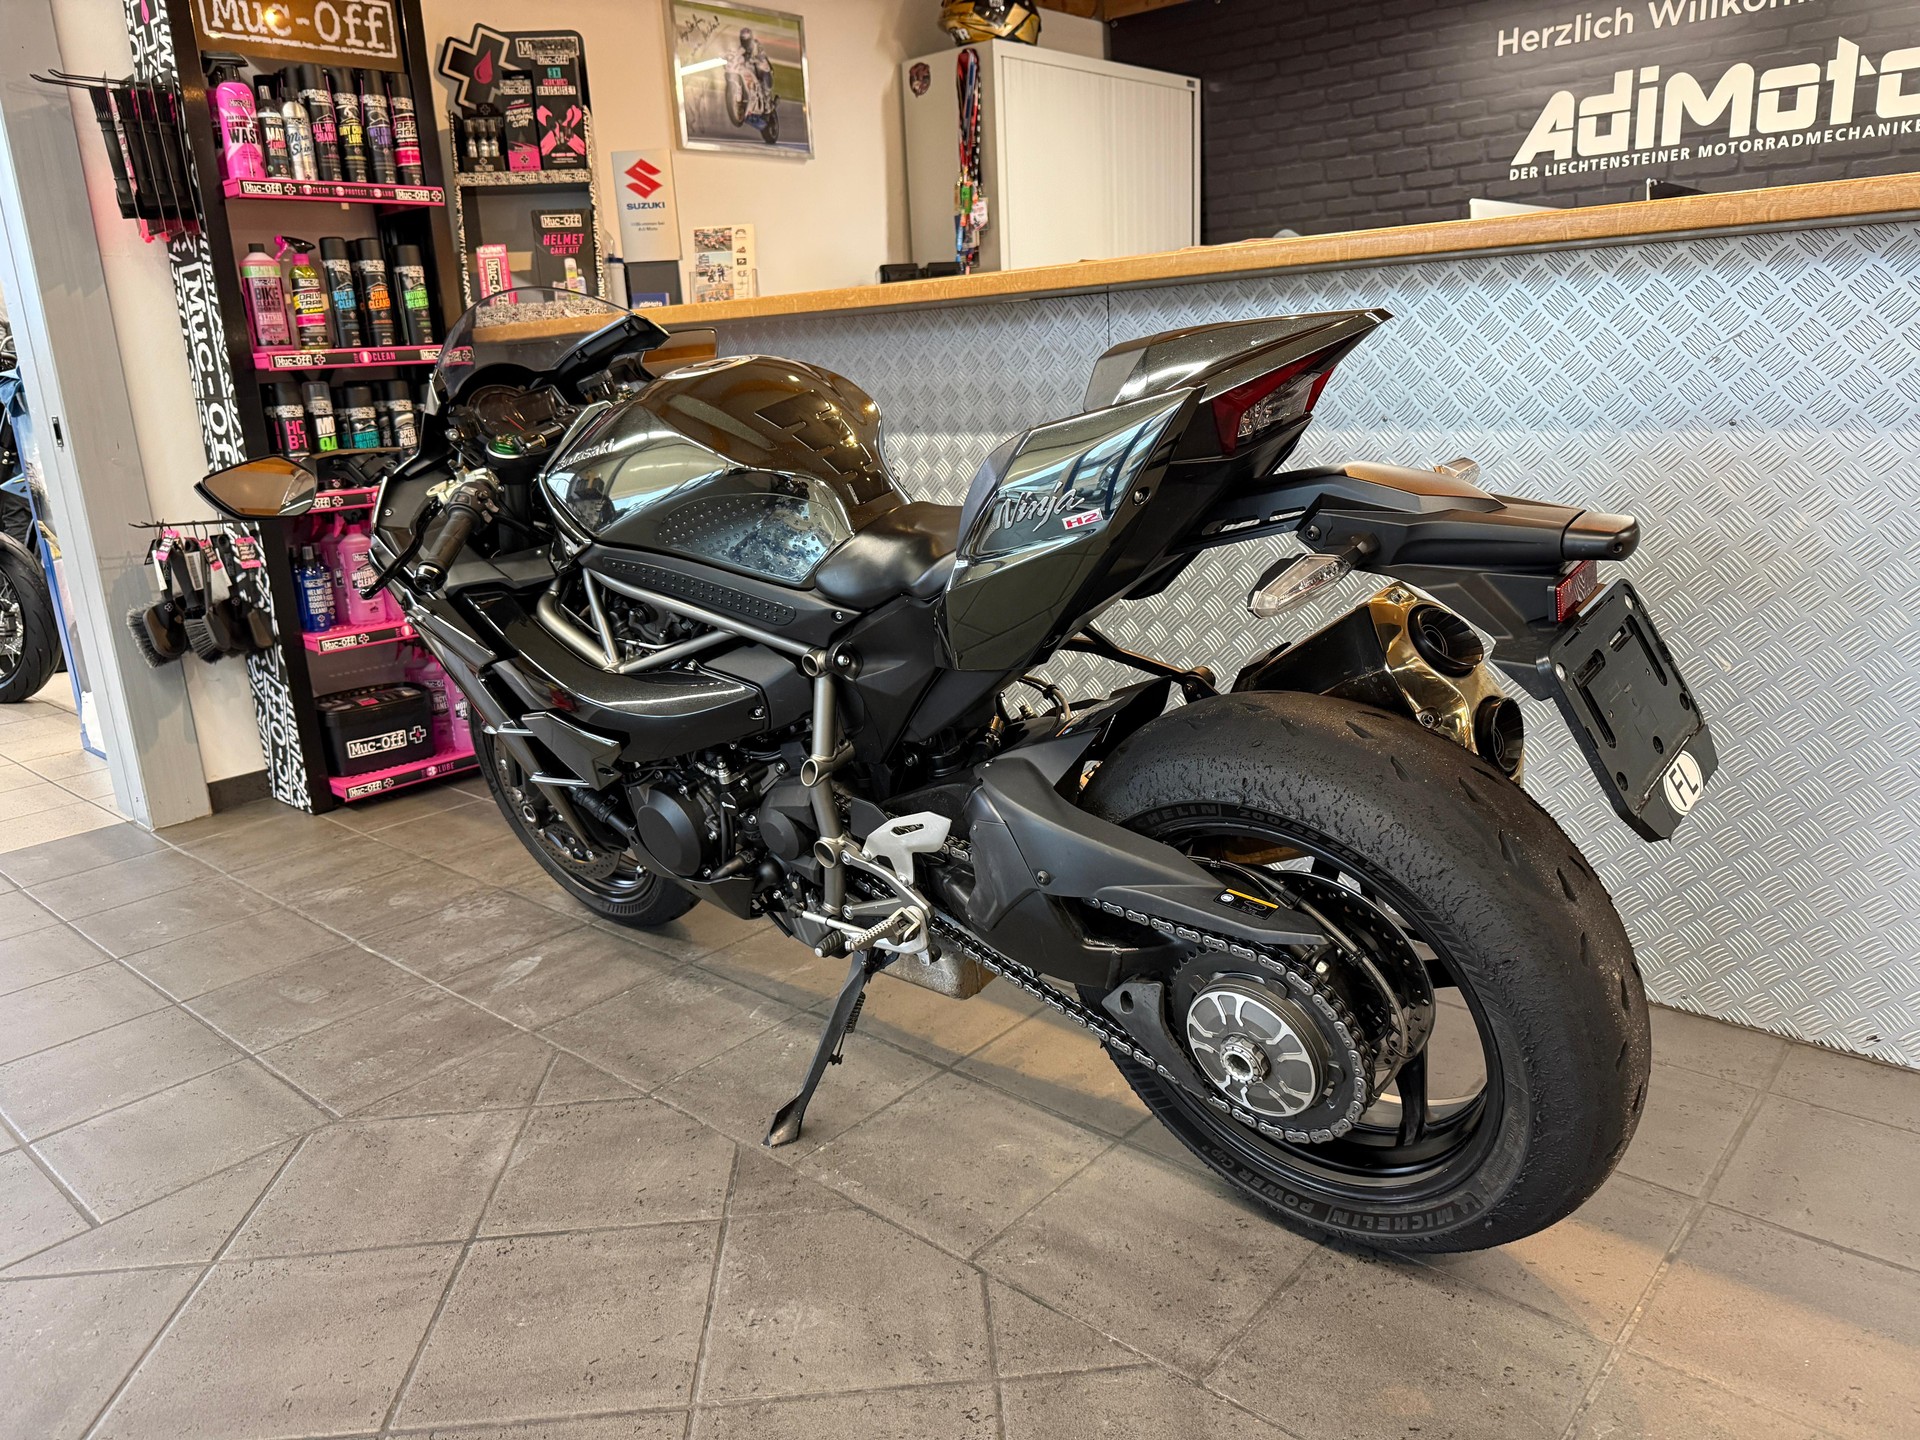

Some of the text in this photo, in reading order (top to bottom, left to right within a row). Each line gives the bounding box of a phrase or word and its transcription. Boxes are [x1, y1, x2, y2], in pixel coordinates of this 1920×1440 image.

[211, 0, 385, 49] Muc-Off
[1497, 0, 1816, 57] Herzlich Willko
[1511, 36, 1920, 166] AdiMoto
[1509, 119, 1920, 181] DER LIECHTENSTEINER MOTORRADMECHANIKE
[543, 215, 581, 227] Muc-Off
[626, 202, 665, 210] SUZUKI
[543, 233, 584, 246] HELMET
[568, 246, 579, 254] KIT
[255, 287, 279, 301] BIKE
[184, 275, 234, 467] Muc-Of
[371, 352, 395, 361] CLEAN
[996, 481, 1084, 532] Ninja
[1066, 512, 1101, 528] H2
[267, 681, 290, 804] uc-Off
[350, 731, 405, 755] Muc-Off
[349, 782, 381, 798] Muc-Off
[438, 762, 455, 773] LUBE
[1669, 762, 1699, 807] FL
[1134, 804, 1218, 828] CHELIN
[1239, 810, 1318, 840] 200/55
[1238, 1167, 1315, 1214] POWER
[1330, 1206, 1455, 1231] MICHELIN
